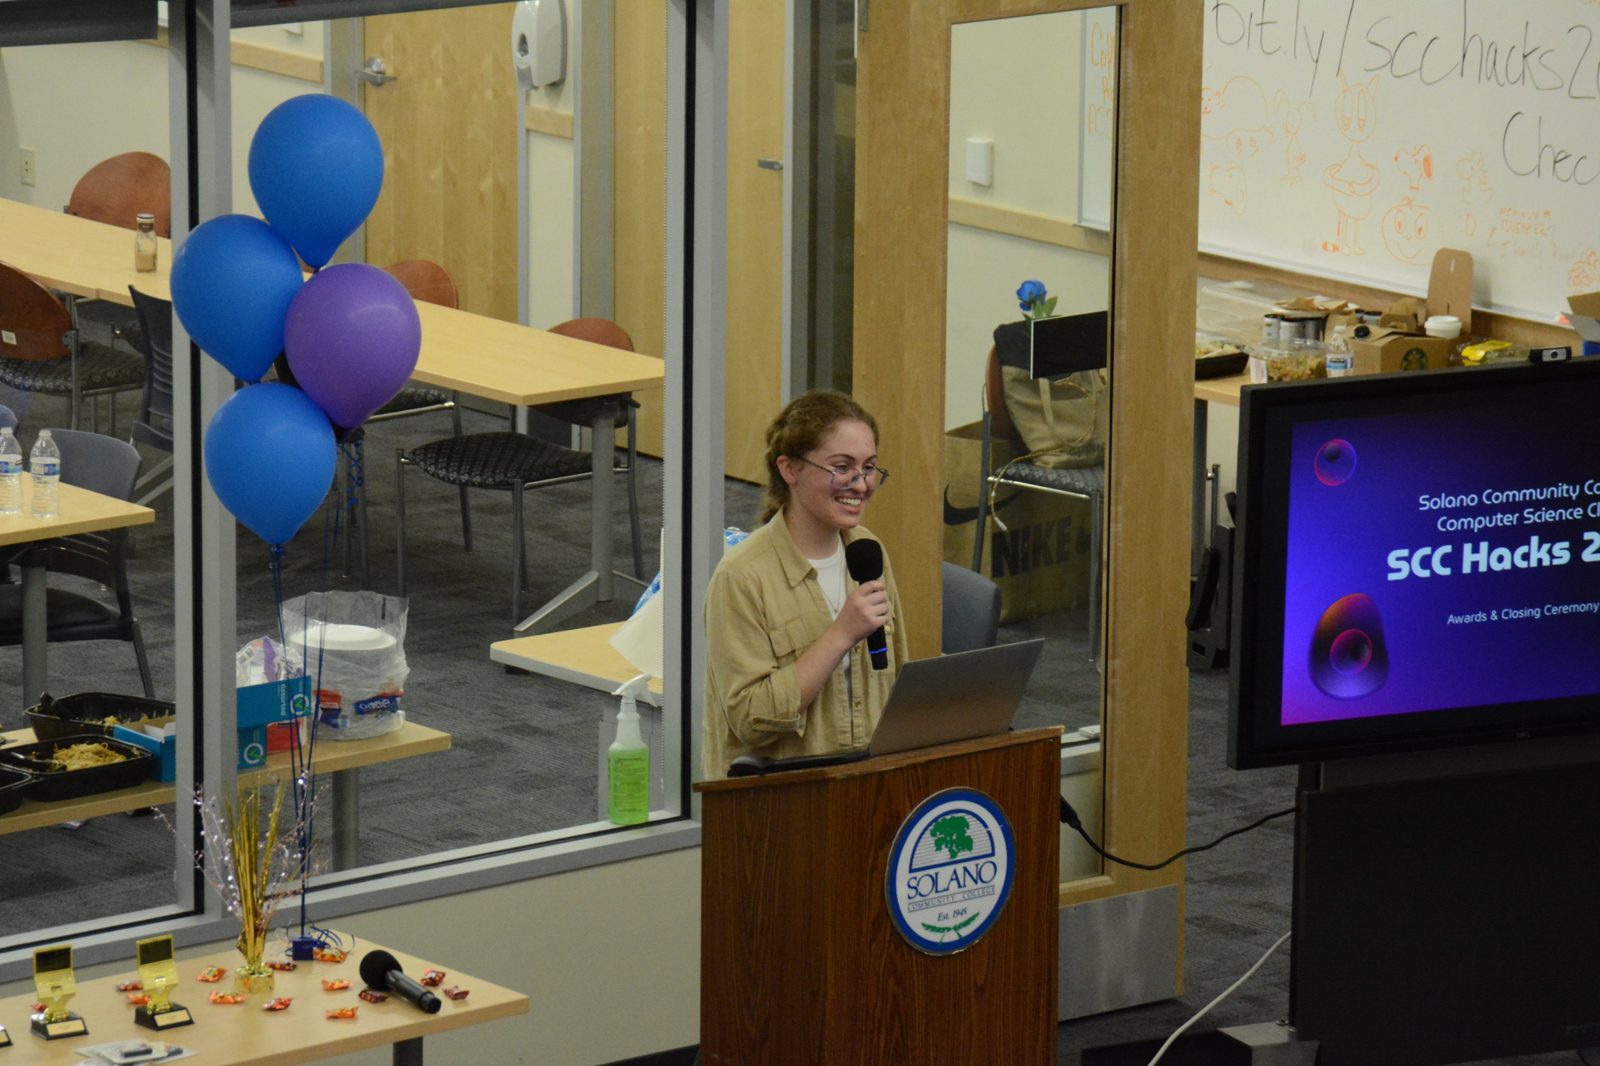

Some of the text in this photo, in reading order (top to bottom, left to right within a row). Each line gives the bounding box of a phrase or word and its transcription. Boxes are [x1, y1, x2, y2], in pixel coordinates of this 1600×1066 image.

[1212, 0, 1600, 99] bit.ly/scchacks2
[1419, 492, 1478, 511] Solano
[1482, 482, 1580, 504] Community
[1437, 512, 1519, 533] Computer
[1523, 507, 1583, 524] Science
[992, 516, 1072, 577] NIKE
[1387, 544, 1452, 581] SCC
[1462, 535, 1571, 574] Hacks
[1447, 600, 1599, 625] Awards & Closing Ceremony
[907, 860, 997, 900] SOLANO
[908, 885, 995, 912] COMMUNITY COLLEGE
